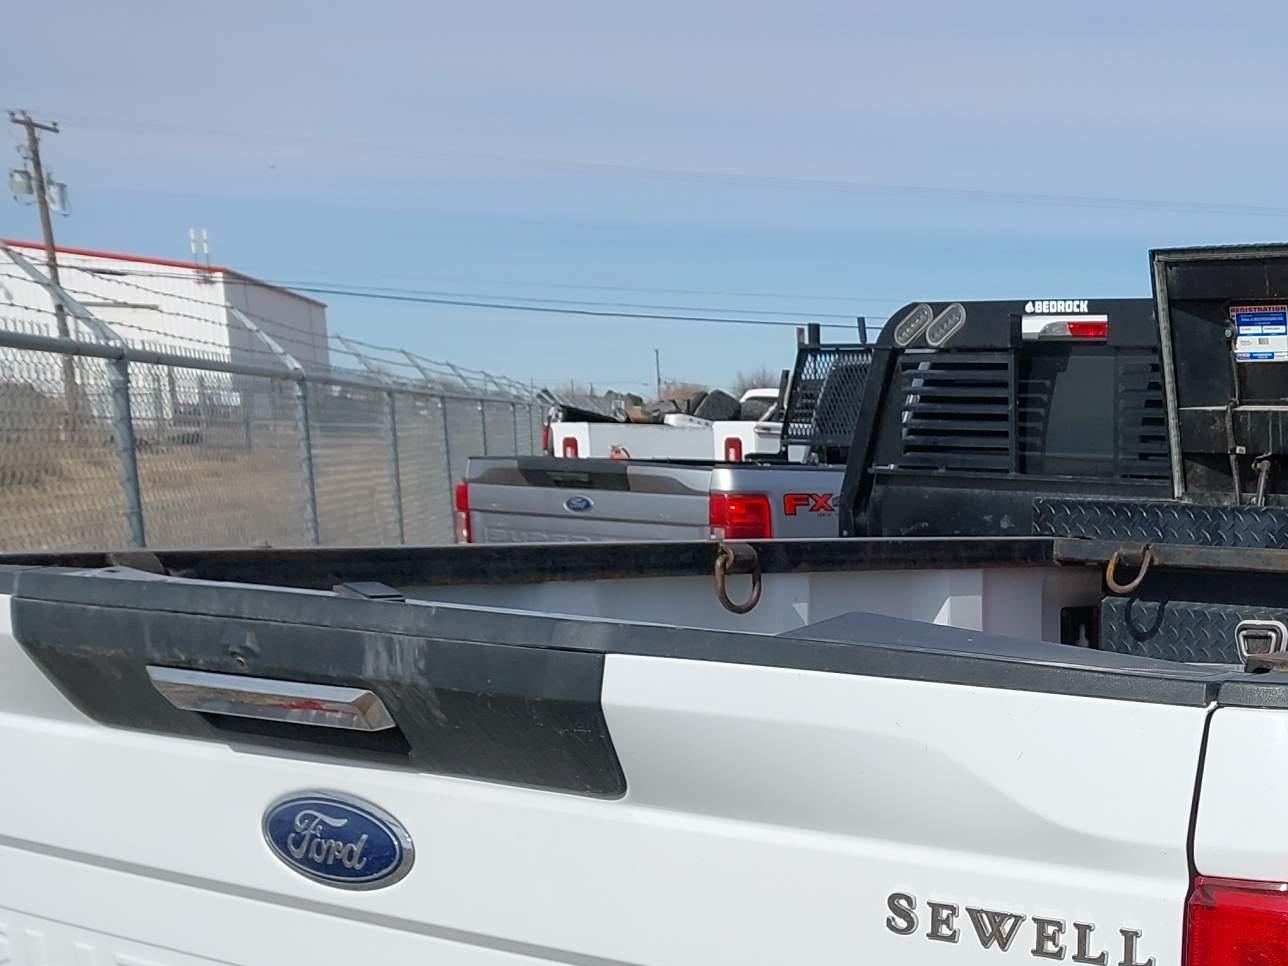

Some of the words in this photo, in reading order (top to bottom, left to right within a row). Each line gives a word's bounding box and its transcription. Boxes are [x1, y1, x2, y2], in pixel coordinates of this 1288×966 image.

[1034, 300, 1089, 313] BEDROCK
[1230, 306, 1287, 314] REGISTRATION
[288, 809, 368, 871] Ford
